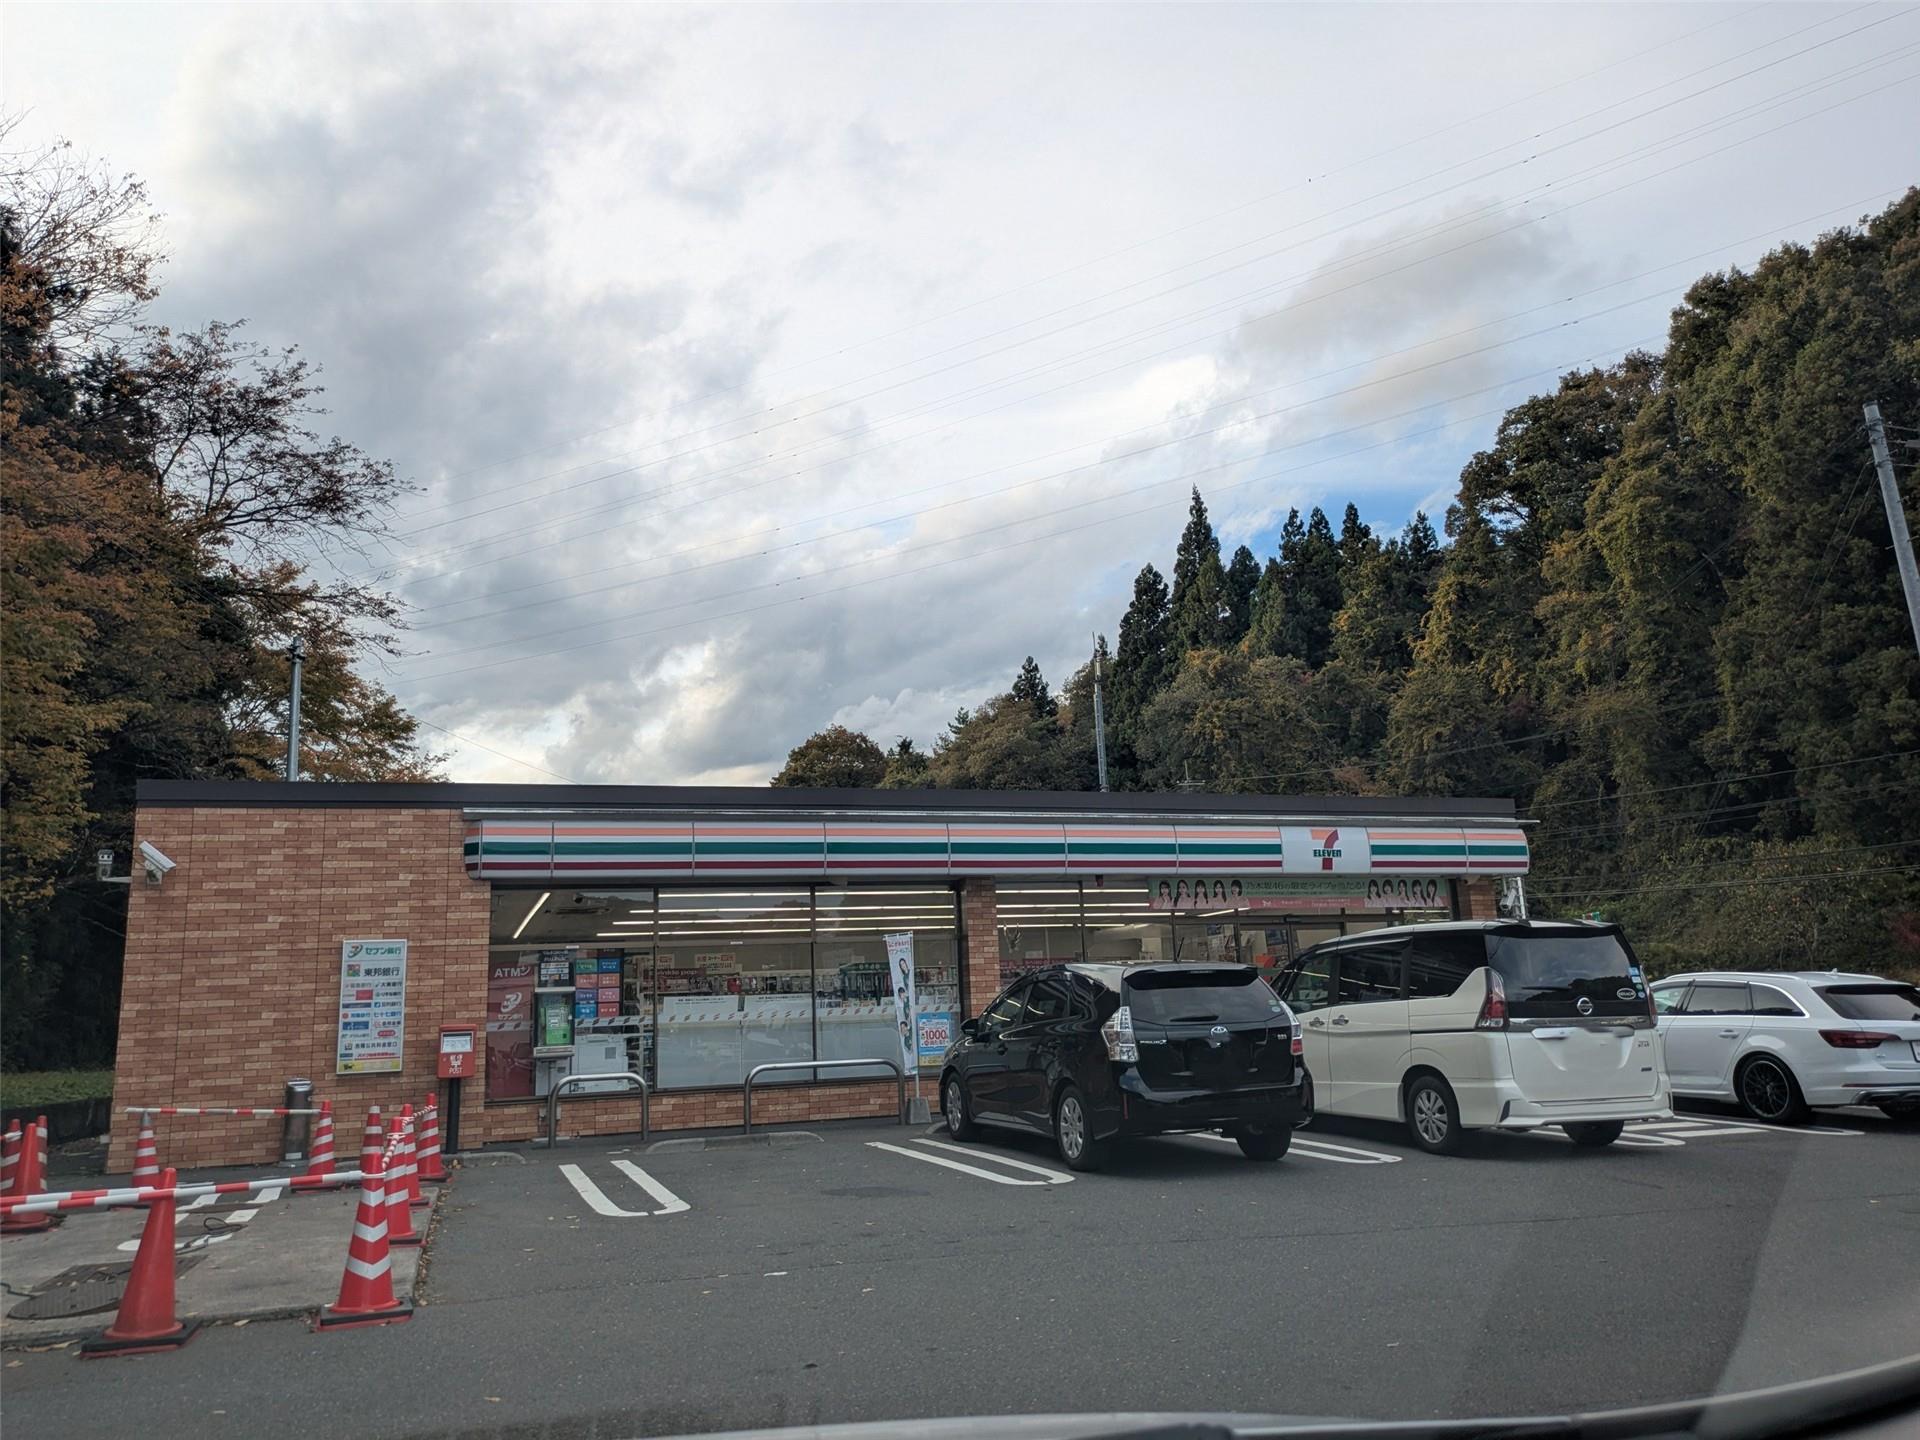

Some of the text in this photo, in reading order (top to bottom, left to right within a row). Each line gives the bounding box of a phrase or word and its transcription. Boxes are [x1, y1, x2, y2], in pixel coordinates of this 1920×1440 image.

[365, 946, 402, 956] セブン銀行
[363, 966, 401, 977] 東邦銀行
[493, 967, 521, 979] ATM
[448, 1066, 462, 1074] POST
